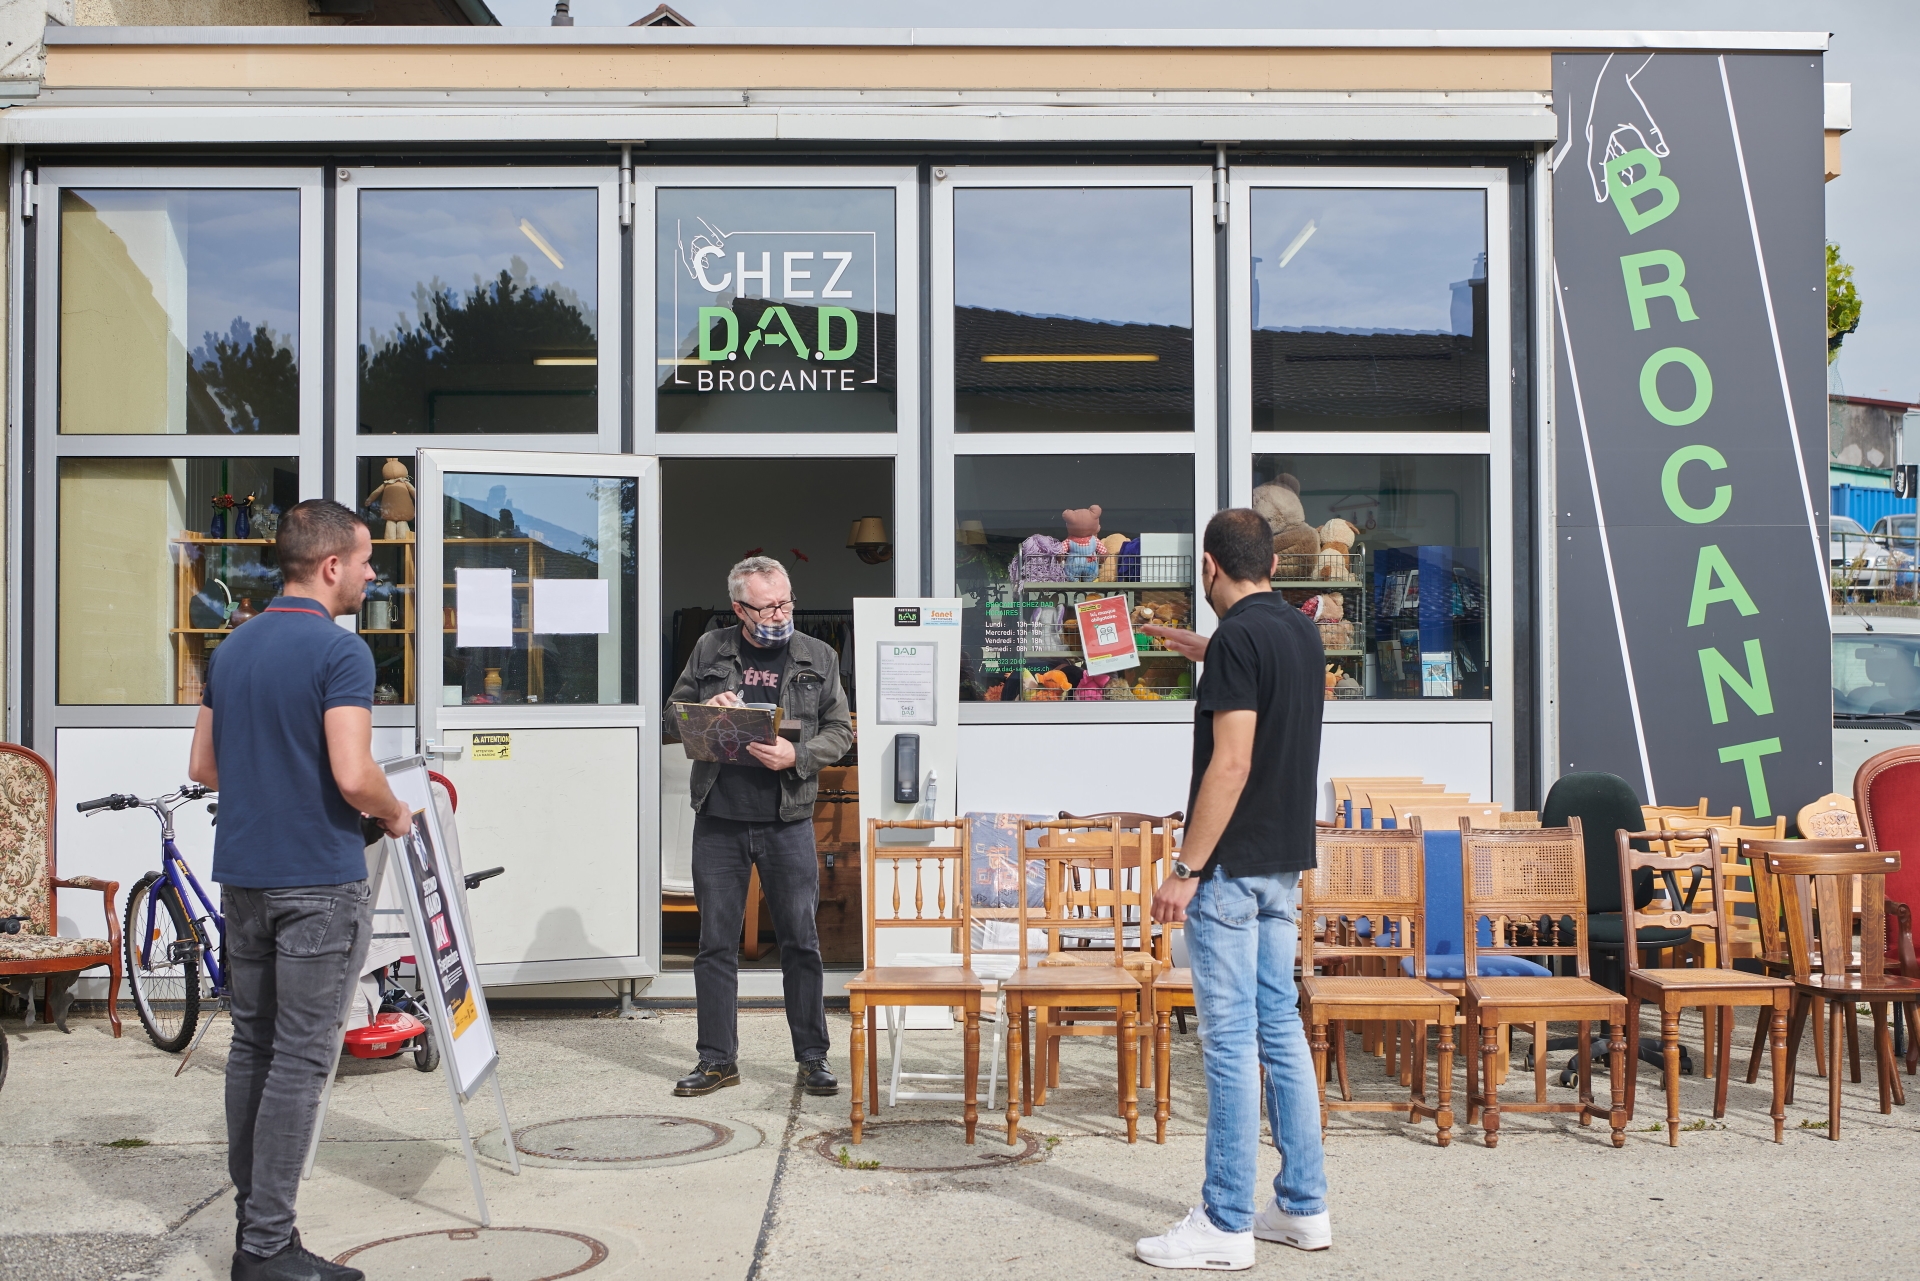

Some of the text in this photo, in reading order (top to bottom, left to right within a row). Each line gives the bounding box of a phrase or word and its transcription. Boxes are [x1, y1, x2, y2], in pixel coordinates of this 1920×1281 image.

[693, 246, 853, 299] CHEZ
[698, 370, 855, 392] BROCANTE
[1604, 148, 1798, 917] BROCANT
[931, 610, 953, 618] Sanet
[424, 892, 442, 918] HAND
[432, 916, 448, 950] DAY
